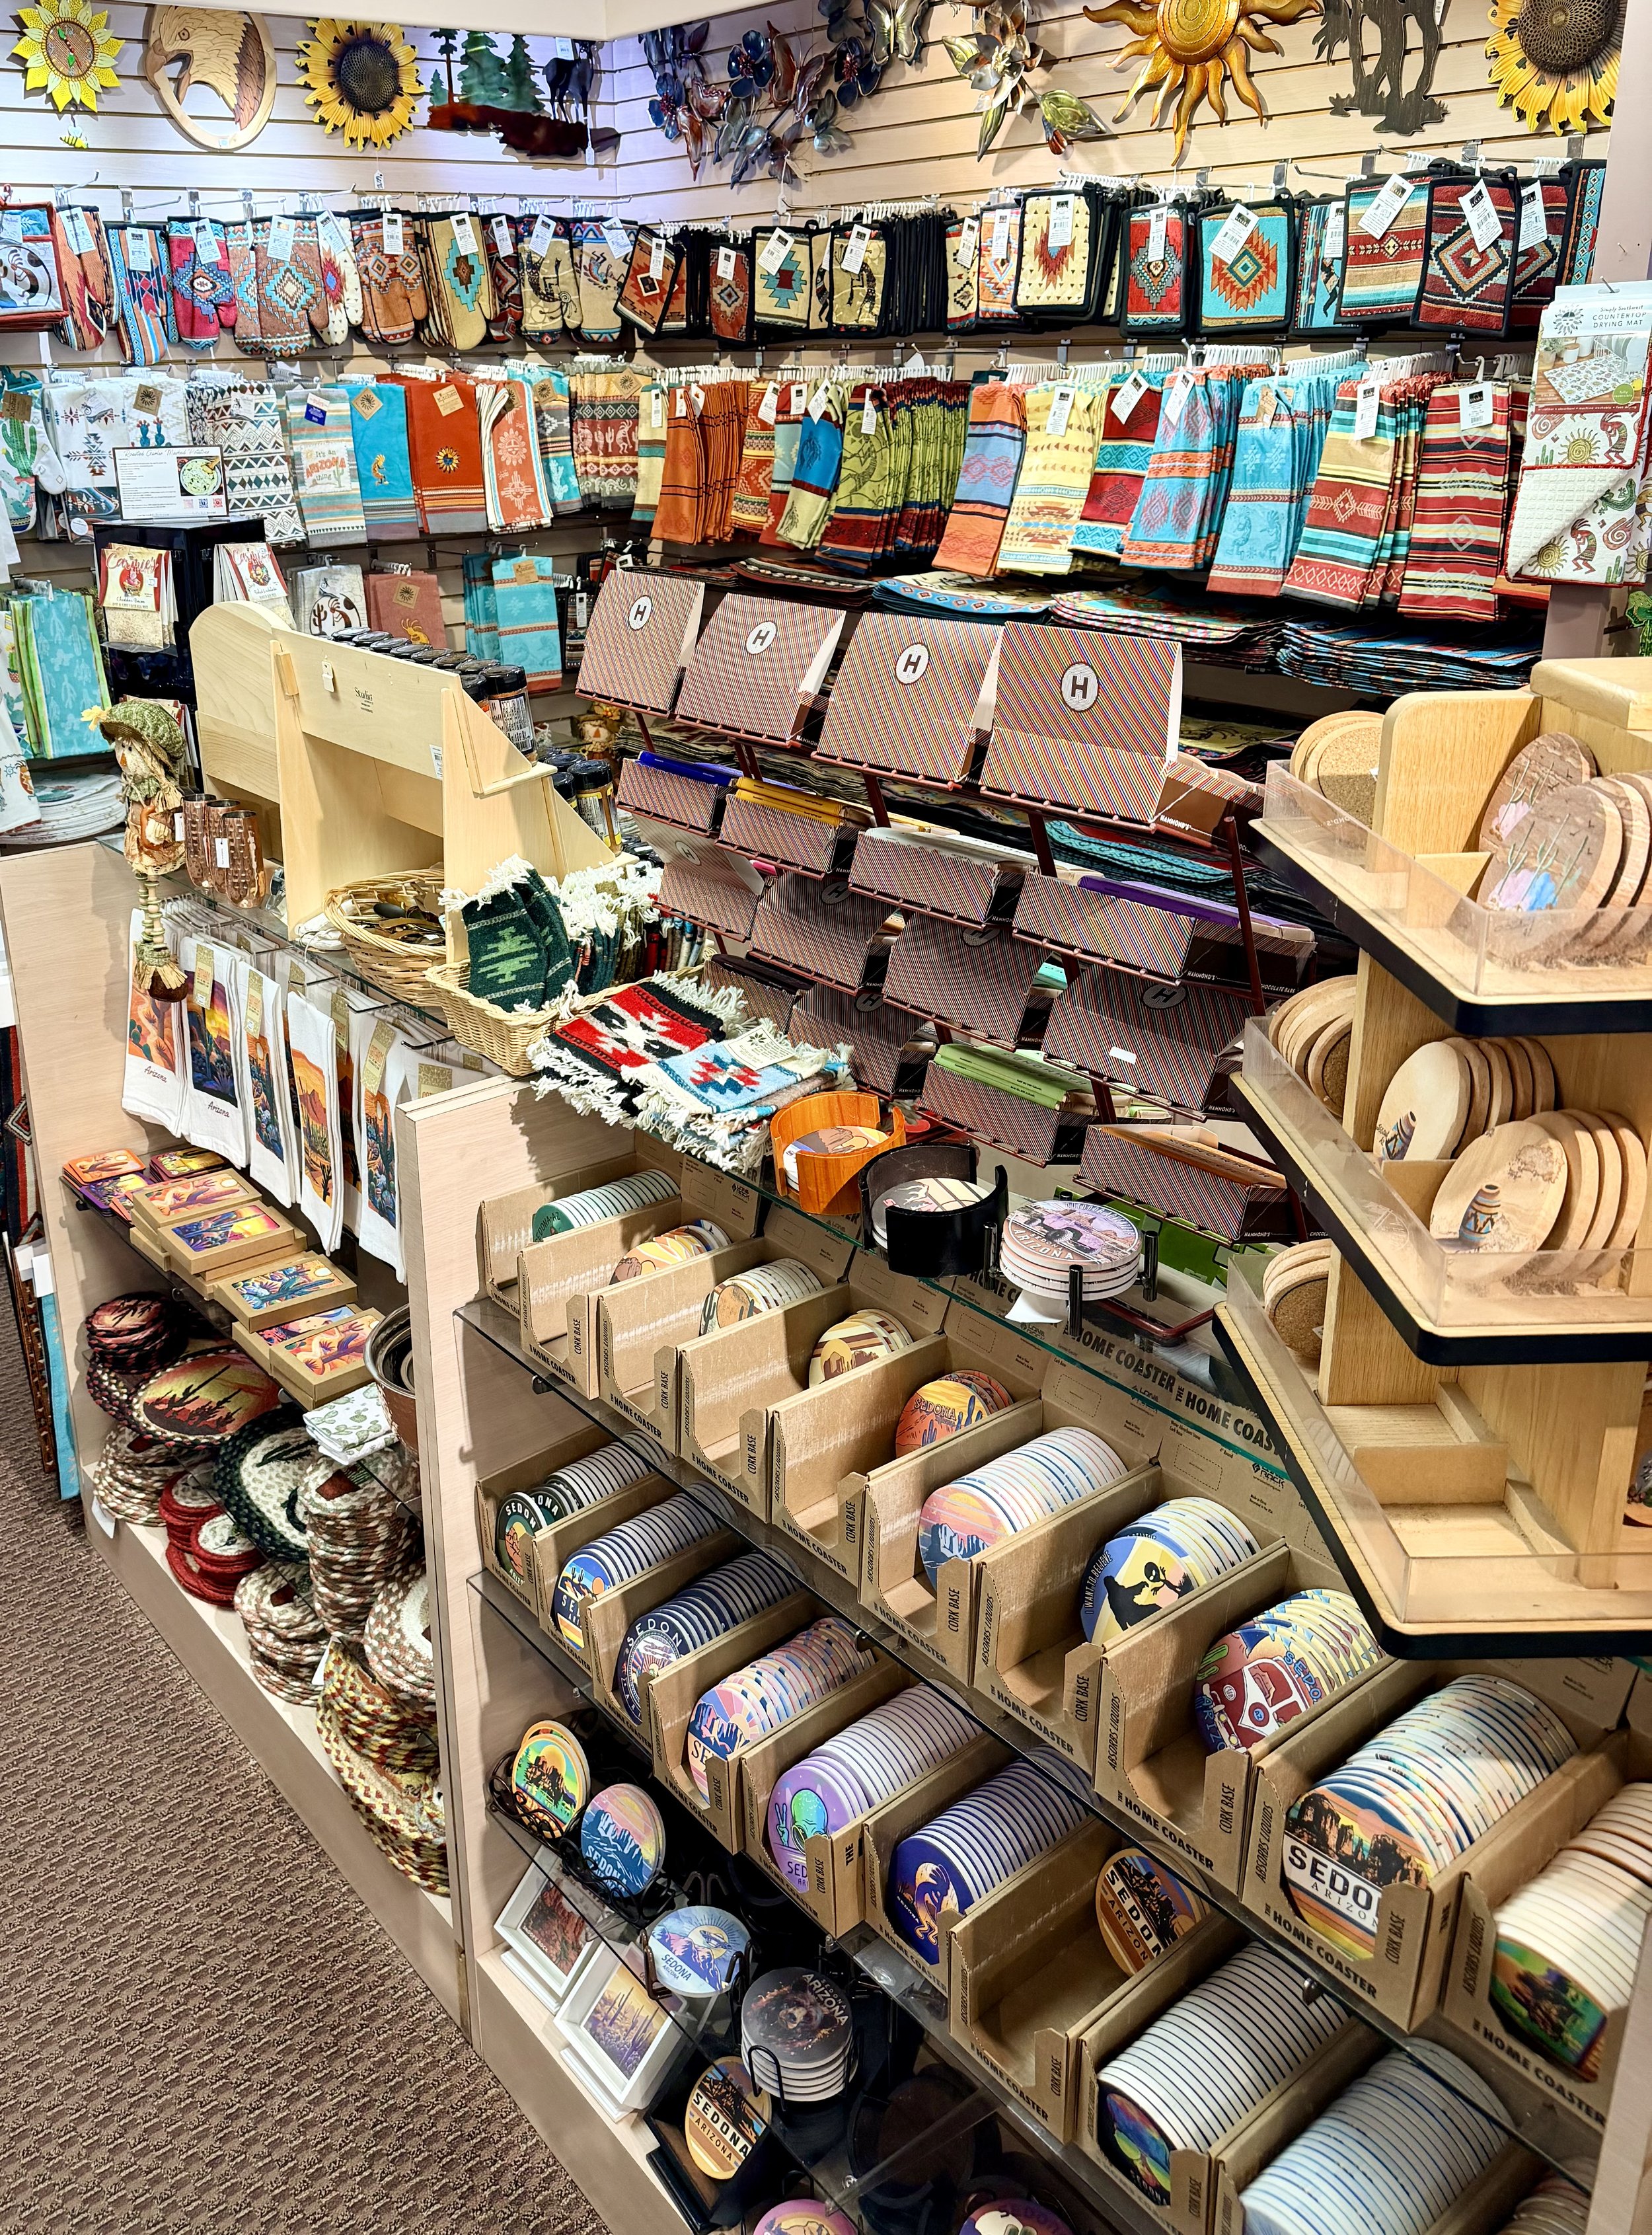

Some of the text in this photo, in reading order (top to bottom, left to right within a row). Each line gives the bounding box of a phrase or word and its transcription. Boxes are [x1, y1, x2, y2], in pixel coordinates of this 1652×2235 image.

[1593, 312, 1647, 321] COUNTERTOP
[305, 456, 346, 478] ARIZONA
[106, 550, 159, 572] Carmie's
[634, 604, 646, 621] H
[752, 629, 770, 646] H
[903, 654, 922, 674] H
[1070, 675, 1088, 699] H
[1160, 815, 1192, 831] HAMMOND'S
[681, 847, 695, 859] H
[827, 883, 847, 899] H
[1187, 970, 1217, 981] HAMMOND'S
[1151, 987, 1177, 1003] H
[144, 1065, 167, 1082] Arizona
[207, 1101, 230, 1118] Arizona
[1013, 1229, 1074, 1260] ARIZONA
[1030, 1233, 1063, 1250] SEDONA
[533, 1348, 576, 1385] HOME COASTER
[1116, 1349, 1176, 1392] COASTER
[1176, 1385, 1185, 1402] THE
[1185, 1390, 1232, 1429] HOME
[614, 1396, 662, 1439] HOME COASTER
[915, 1398, 957, 1421] SEDONA
[747, 1434, 757, 1474] CORK BASE
[695, 1457, 750, 1505] HOME COASTER
[1261, 1468, 1285, 1489] ROCK
[506, 1502, 537, 1529] SEDON
[845, 1500, 856, 1544] CORK BASE
[867, 1515, 876, 1546] LIQUIDS
[786, 1523, 848, 1575] HOME COASTER
[1090, 1550, 1113, 1578] BELIEVE
[509, 1583, 531, 1607] COASTER
[1086, 1575, 1097, 1588] TO
[948, 1587, 961, 1632] CORK BASE
[1085, 1587, 1095, 1610] WANT
[626, 1618, 683, 1647] SEDON
[879, 1606, 948, 1667] HOME COASTER
[981, 1593, 995, 1668] ABSORBS LIQUIDS
[566, 1644, 592, 1673] COASTER
[1283, 1651, 1322, 1703] SEDO
[1074, 1675, 1090, 1722] CORK BASE
[996, 1688, 1074, 1756] HOME COASTER
[1255, 1710, 1263, 1720] AZ
[625, 1720, 653, 1751] COASTER
[1108, 1692, 1121, 1771] ABSORBS LIQUIDS
[712, 1776, 722, 1794] BASE
[668, 1779, 718, 1835] HOME COASTER
[1219, 1782, 1236, 1834] CORK BASE
[1123, 1796, 1160, 1831] HOME
[1161, 1825, 1215, 1872] COASTER
[1256, 1800, 1274, 1883] ABSORBS LIQUIDS
[814, 1857, 826, 1894] CORK BASE
[1288, 1844, 1382, 1911] SEDO
[896, 1895, 919, 1924] SEDONA
[1108, 1899, 1148, 1961] ARIZON
[1384, 1911, 1406, 1965] CORK BASE
[661, 1953, 693, 1983] SEDONA
[884, 1932, 948, 1993] HOME COASTER
[1273, 1911, 1314, 1950] HOME
[1316, 1944, 1378, 2000] COASTER
[1462, 1911, 1485, 1997] ABSORBS LIQUIDS
[662, 1965, 680, 1981] ARIZONA
[802, 1973, 850, 2026] ARIZONA
[977, 2045, 1049, 2123] HOME COASTER
[1051, 2055, 1062, 2097] CORK BASE
[1482, 2027, 1608, 2127] HOME COASTER
[693, 2092, 749, 2158] SEDONA
[695, 2117, 732, 2161] ARIZONA
